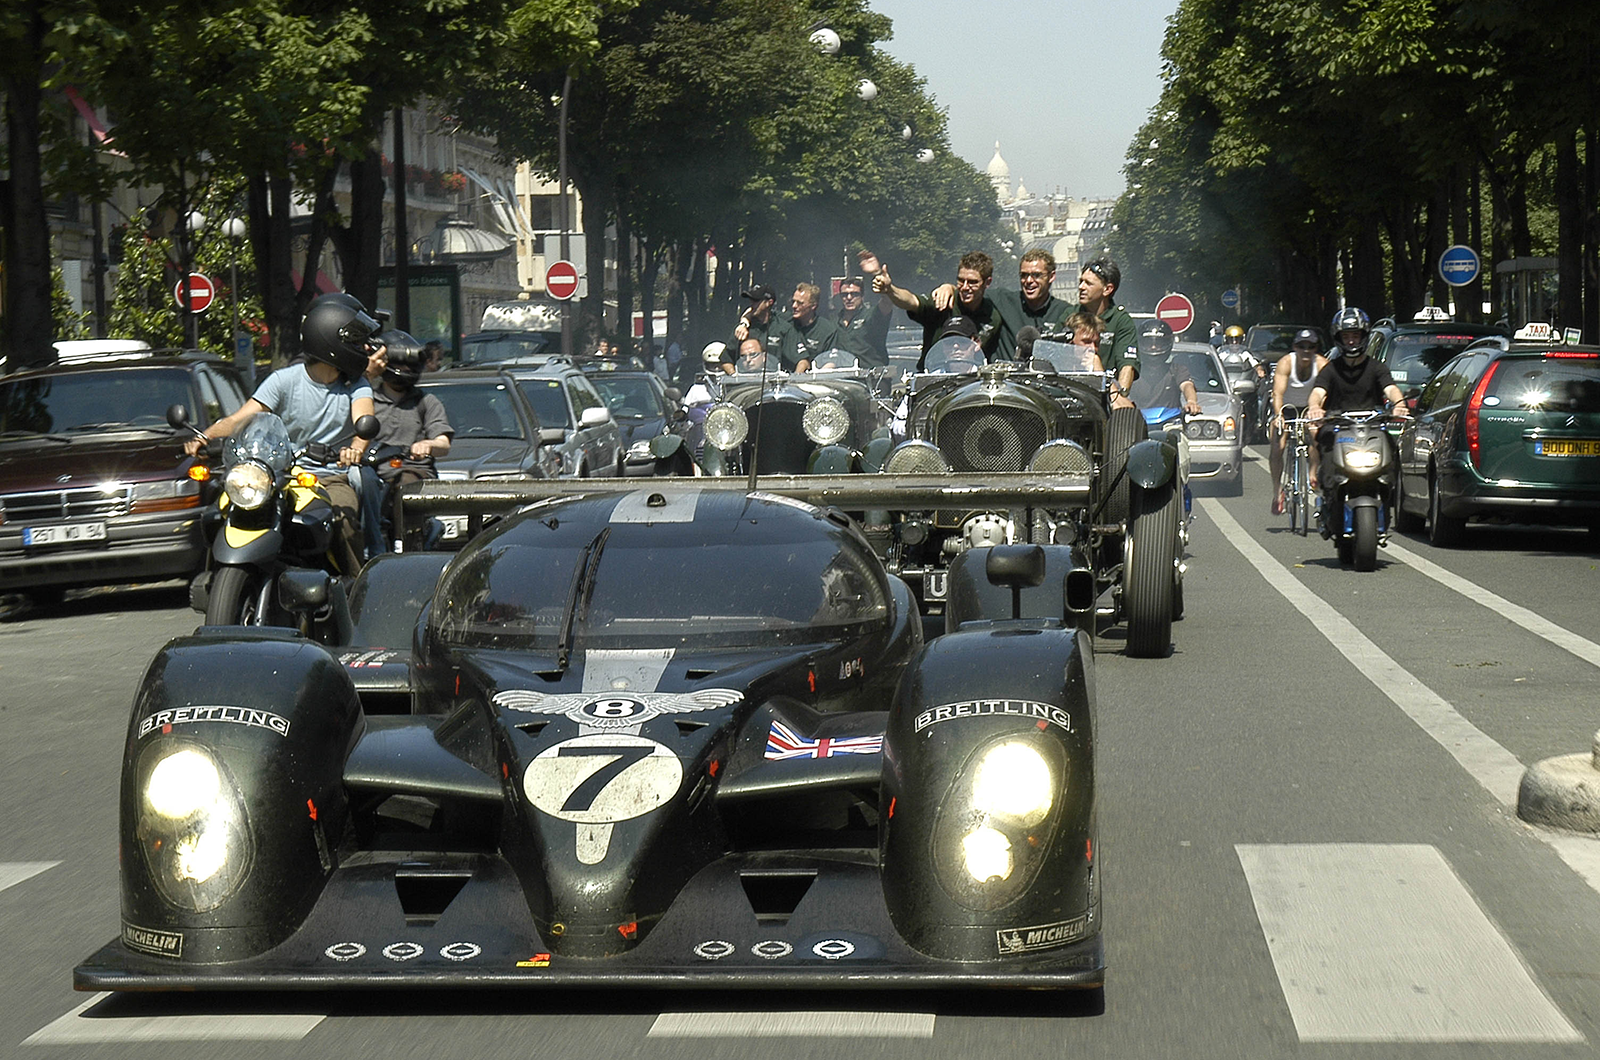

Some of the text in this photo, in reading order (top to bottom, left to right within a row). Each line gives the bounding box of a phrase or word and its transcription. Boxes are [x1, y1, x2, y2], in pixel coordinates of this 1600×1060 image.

[1529, 325, 1548, 334] TAXI
[1543, 441, 1566, 453] 900
[1567, 441, 1590, 453] DNH
[930, 573, 947, 597] U
[141, 707, 287, 732] BREITLING
[592, 700, 635, 717] B
[918, 700, 1069, 728] BREITLING
[558, 747, 656, 811] 7
[126, 927, 178, 949] MICHELIN
[1026, 922, 1085, 945] MICHELIN
